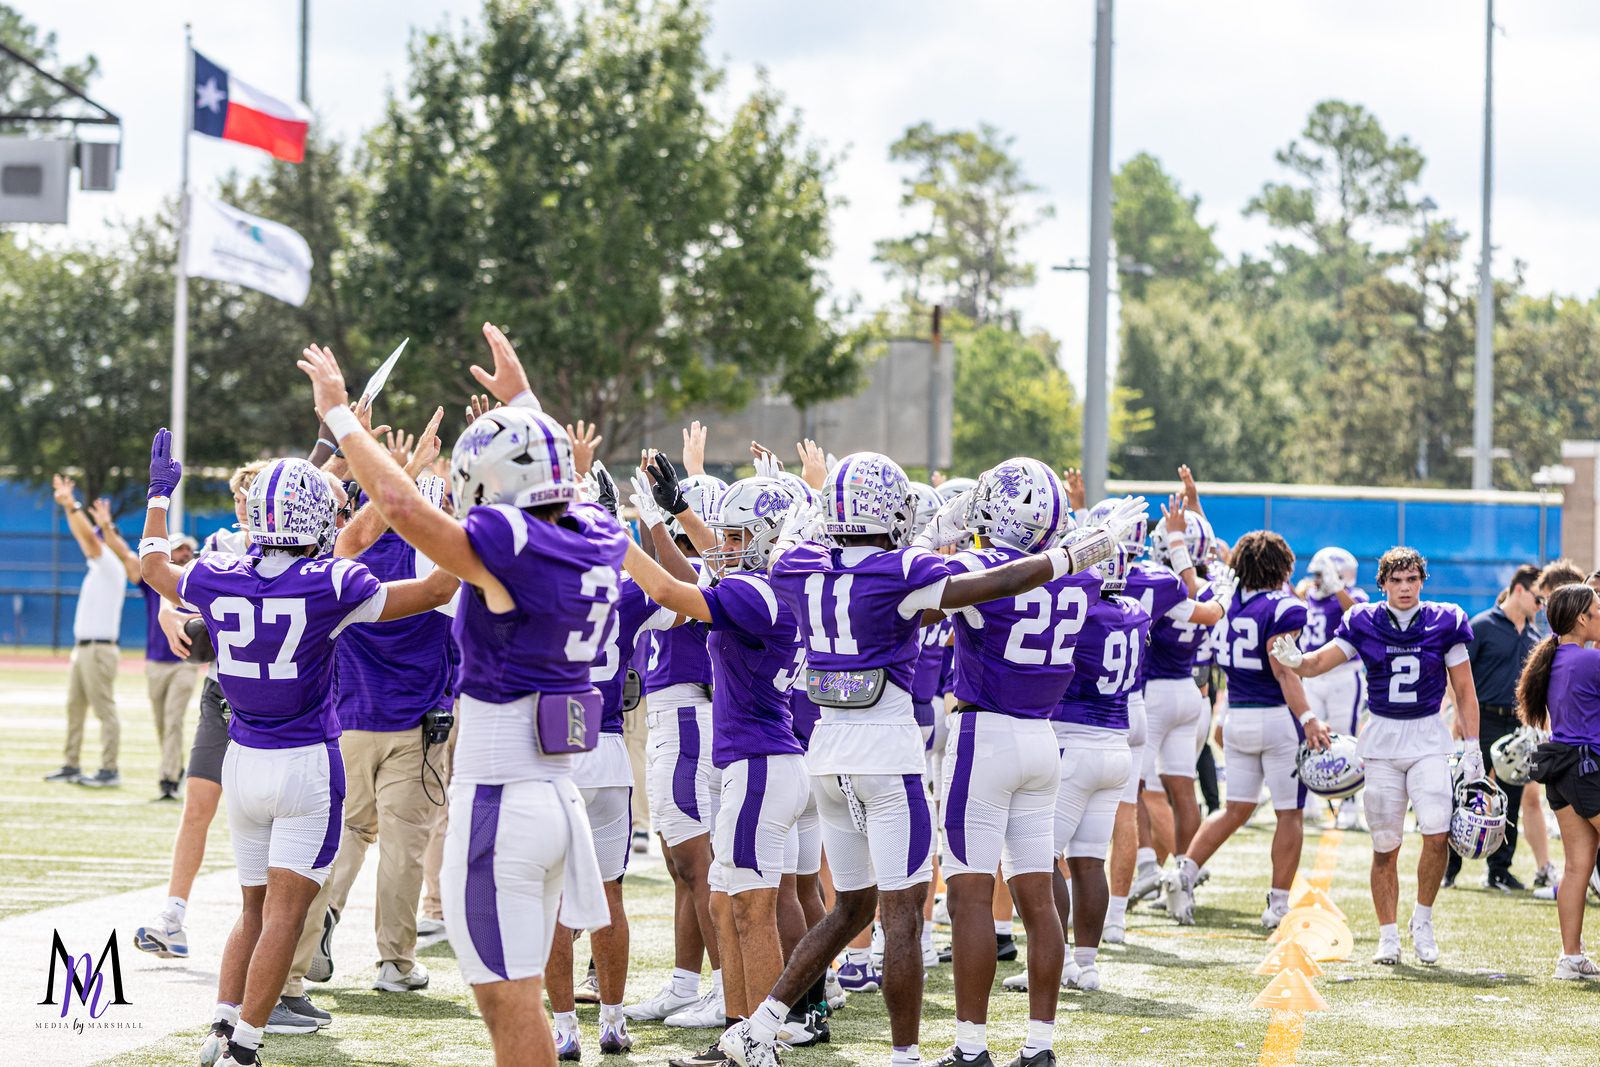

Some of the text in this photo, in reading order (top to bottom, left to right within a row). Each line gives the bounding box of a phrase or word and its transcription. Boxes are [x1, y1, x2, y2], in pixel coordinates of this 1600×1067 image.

[530, 488, 560, 503] REIGN
[852, 499, 860, 516] 1
[253, 509, 293, 528] 2 7
[826, 523, 867, 533] REIGN CAIN
[275, 536, 300, 545] CAIN
[1019, 530, 1034, 546] 2
[1107, 562, 1115, 576] 9
[804, 572, 860, 656] 11
[1003, 586, 1088, 666] 22
[209, 596, 308, 680] 27
[1210, 616, 1263, 671] 42
[1096, 628, 1140, 695] 91
[1388, 655, 1421, 704] 2
